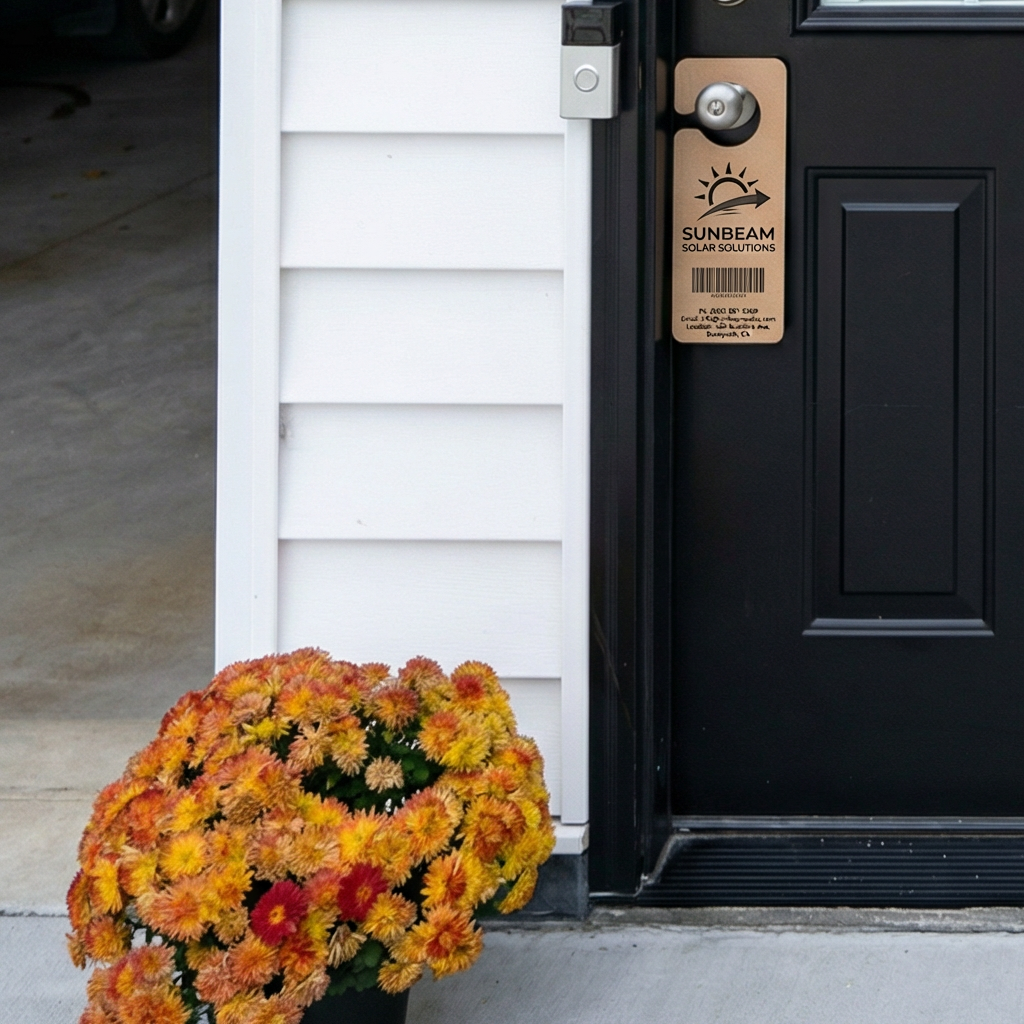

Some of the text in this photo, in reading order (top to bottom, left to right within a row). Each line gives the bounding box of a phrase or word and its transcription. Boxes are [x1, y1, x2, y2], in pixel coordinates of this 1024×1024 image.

[682, 227, 775, 241] SUNBEAM
[682, 243, 776, 252] SOLAR SOLUTIONS
